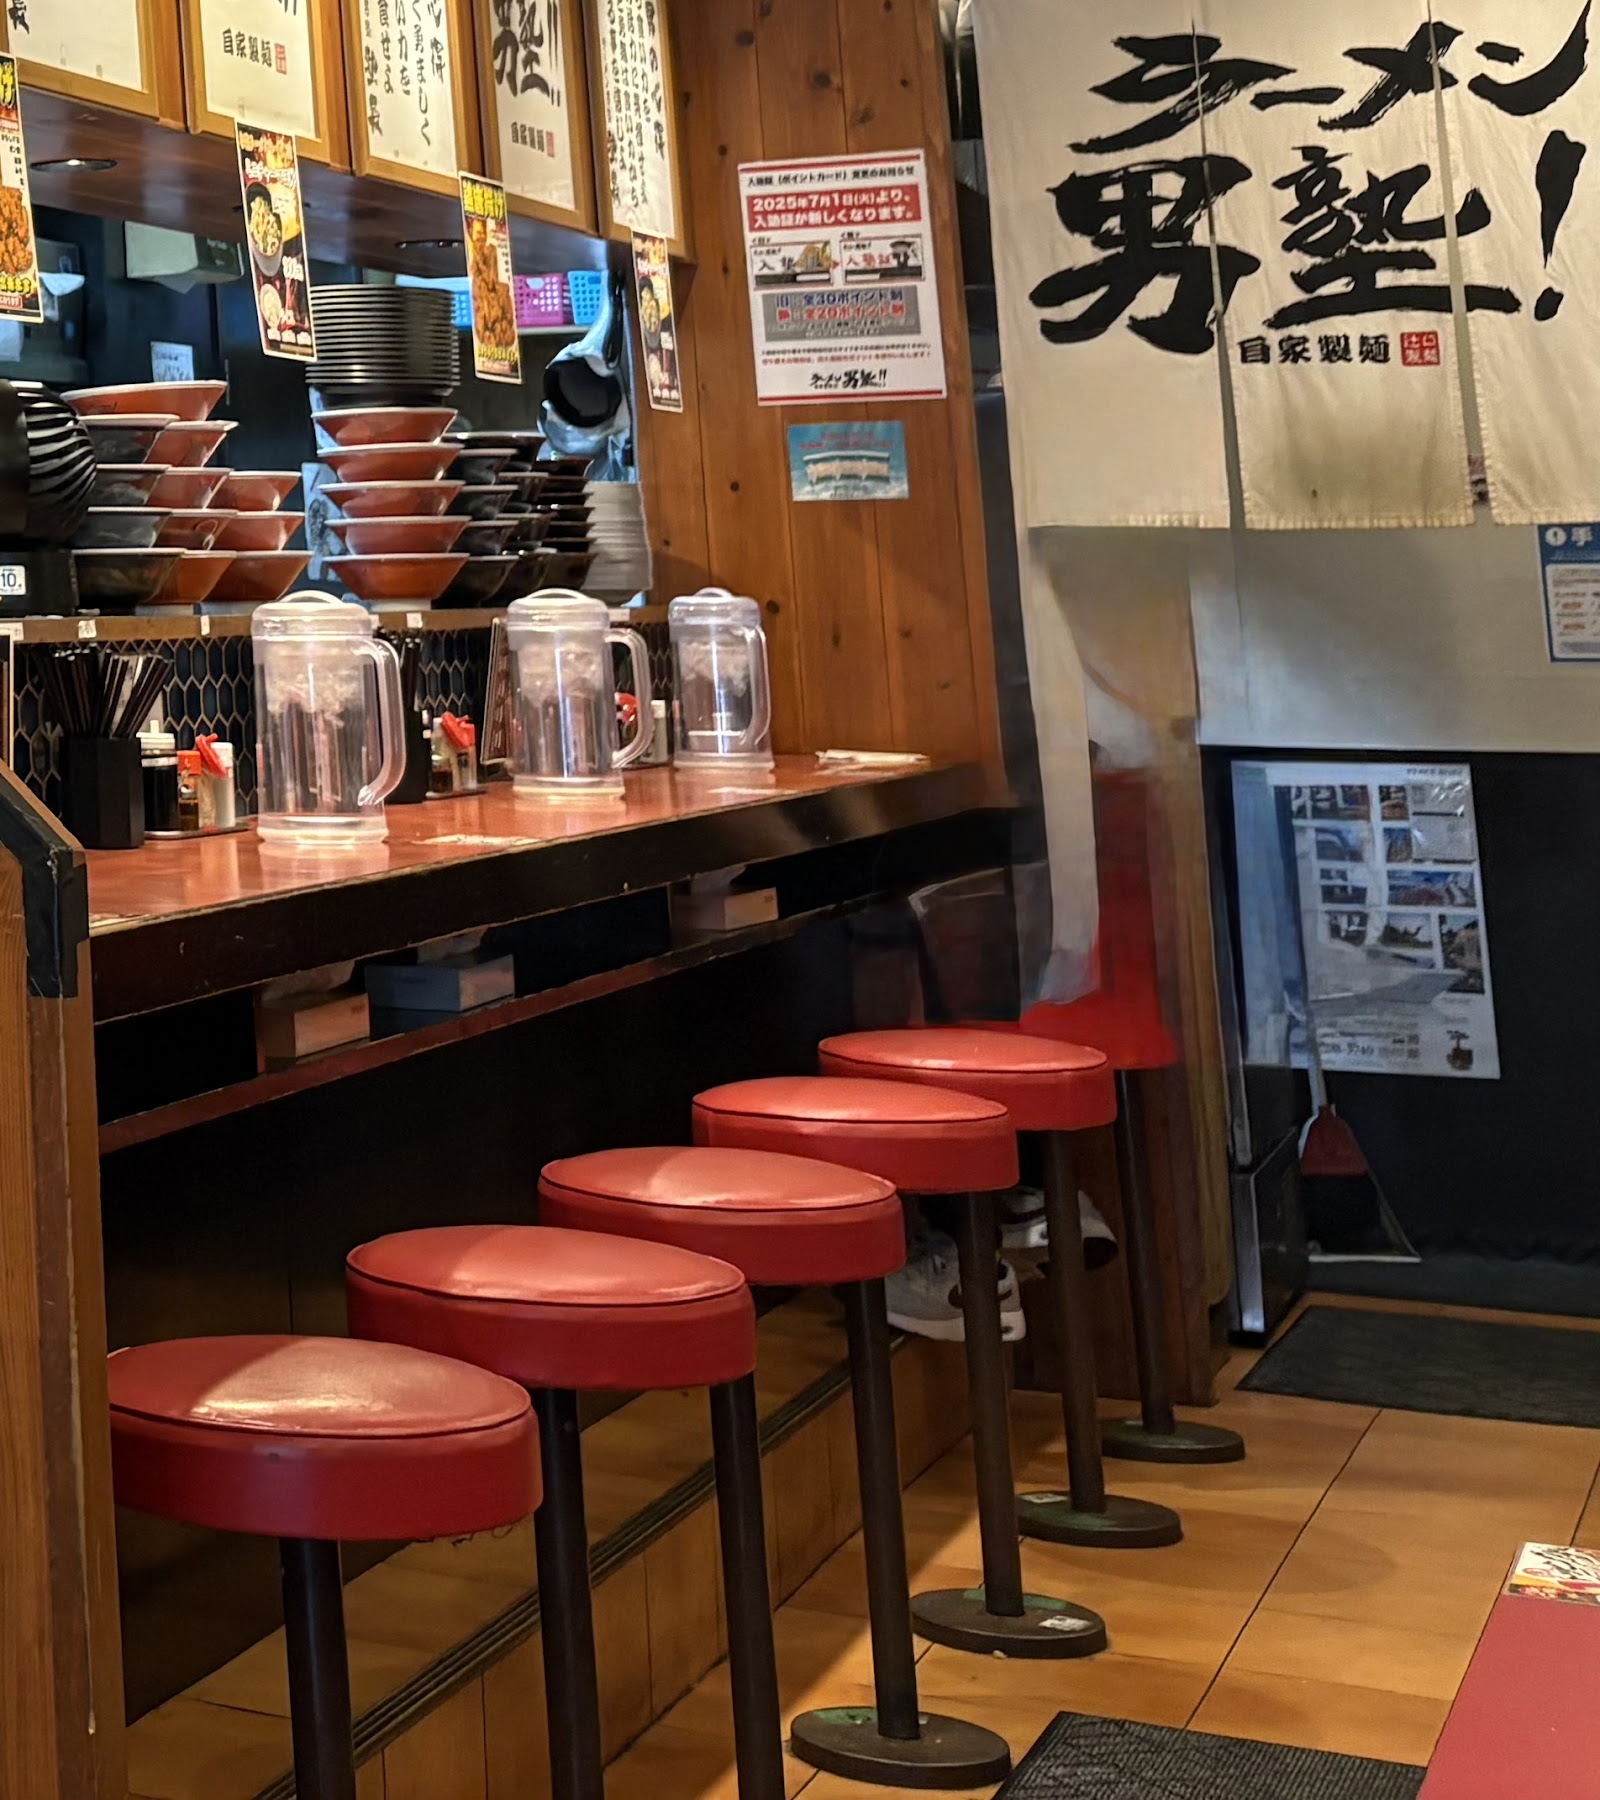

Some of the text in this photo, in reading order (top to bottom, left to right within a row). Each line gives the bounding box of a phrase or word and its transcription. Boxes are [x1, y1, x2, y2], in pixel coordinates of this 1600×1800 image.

[1067, 0, 1591, 154] ラーメン
[1237, 334, 1390, 364] 自家製麺
